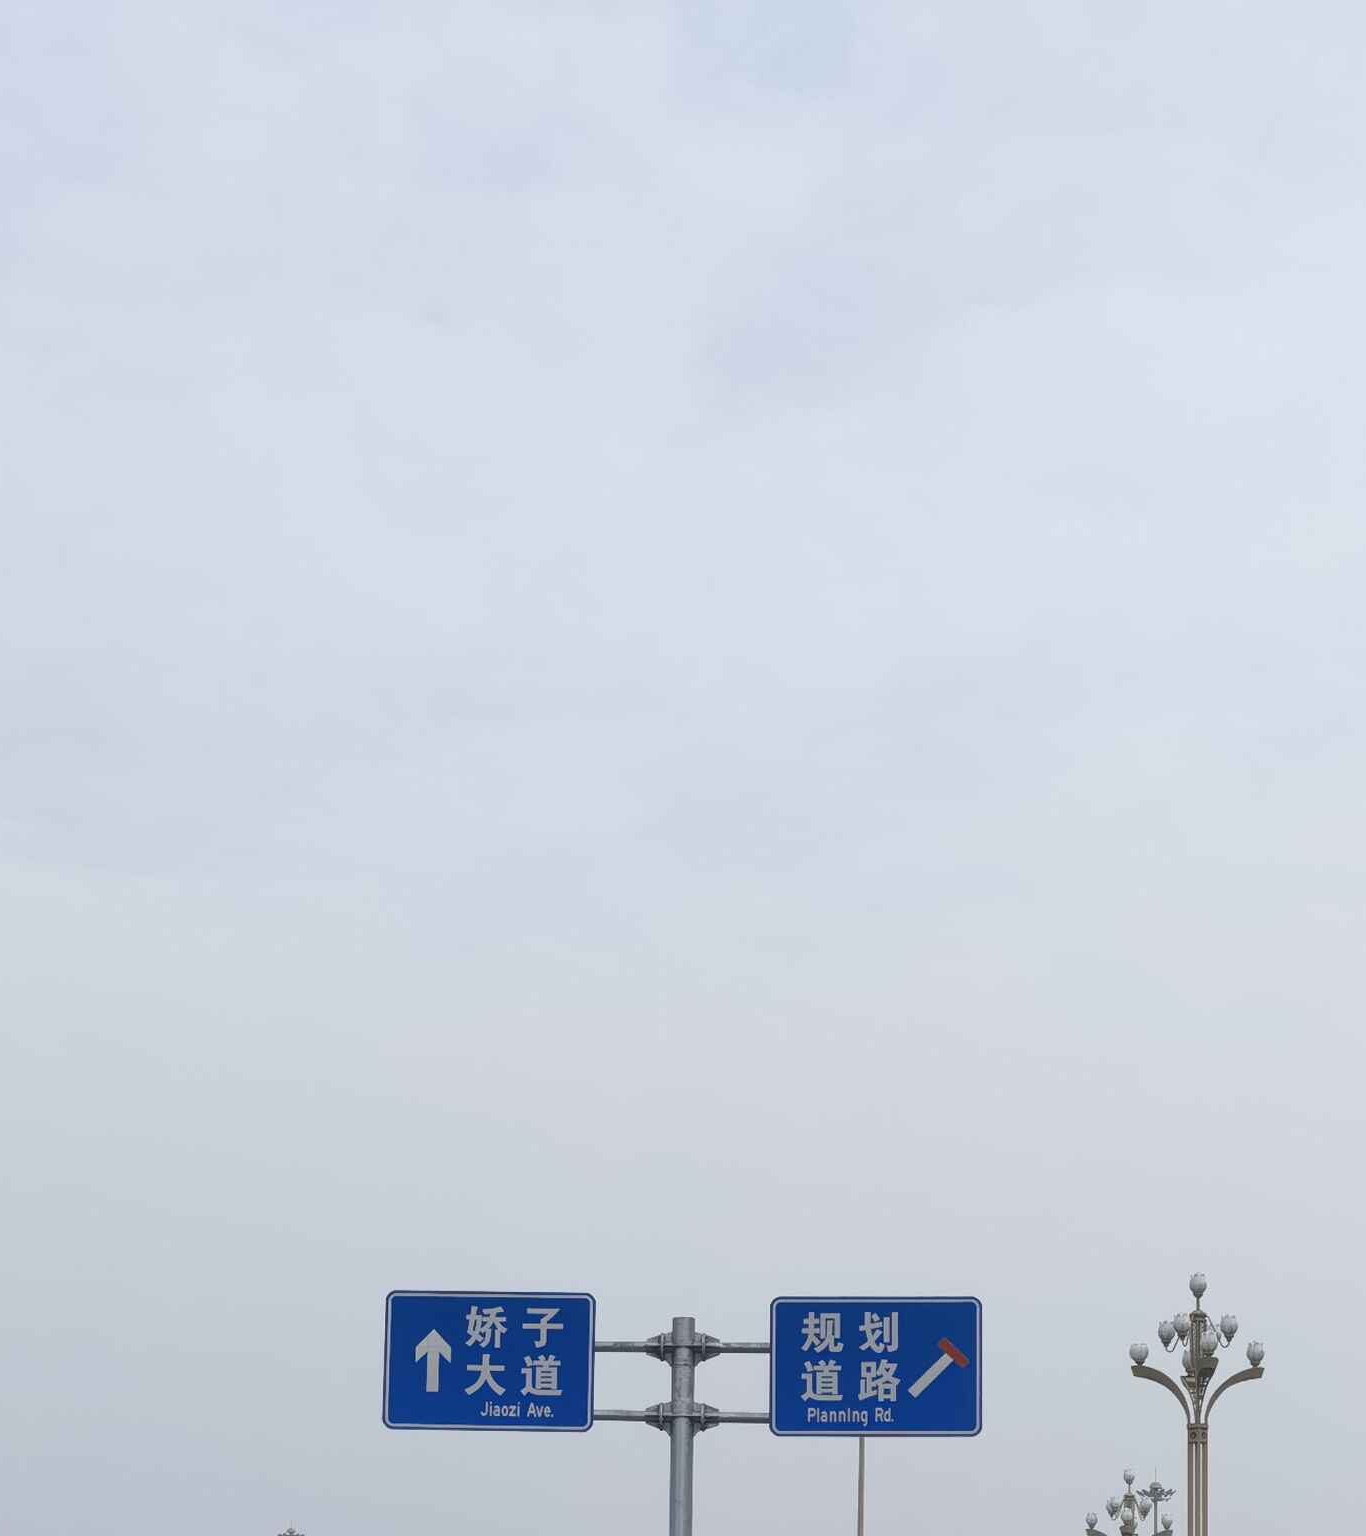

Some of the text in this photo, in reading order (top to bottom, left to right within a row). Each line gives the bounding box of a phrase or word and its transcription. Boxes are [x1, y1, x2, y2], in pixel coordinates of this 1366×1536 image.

[465, 1305, 564, 1349] 娇子
[801, 1311, 899, 1353] 规划
[464, 1353, 563, 1396] 大道
[801, 1359, 901, 1402] 道路
[480, 1401, 555, 1418] Jiaozi Ave.
[807, 1407, 895, 1427] Planning Rd.
